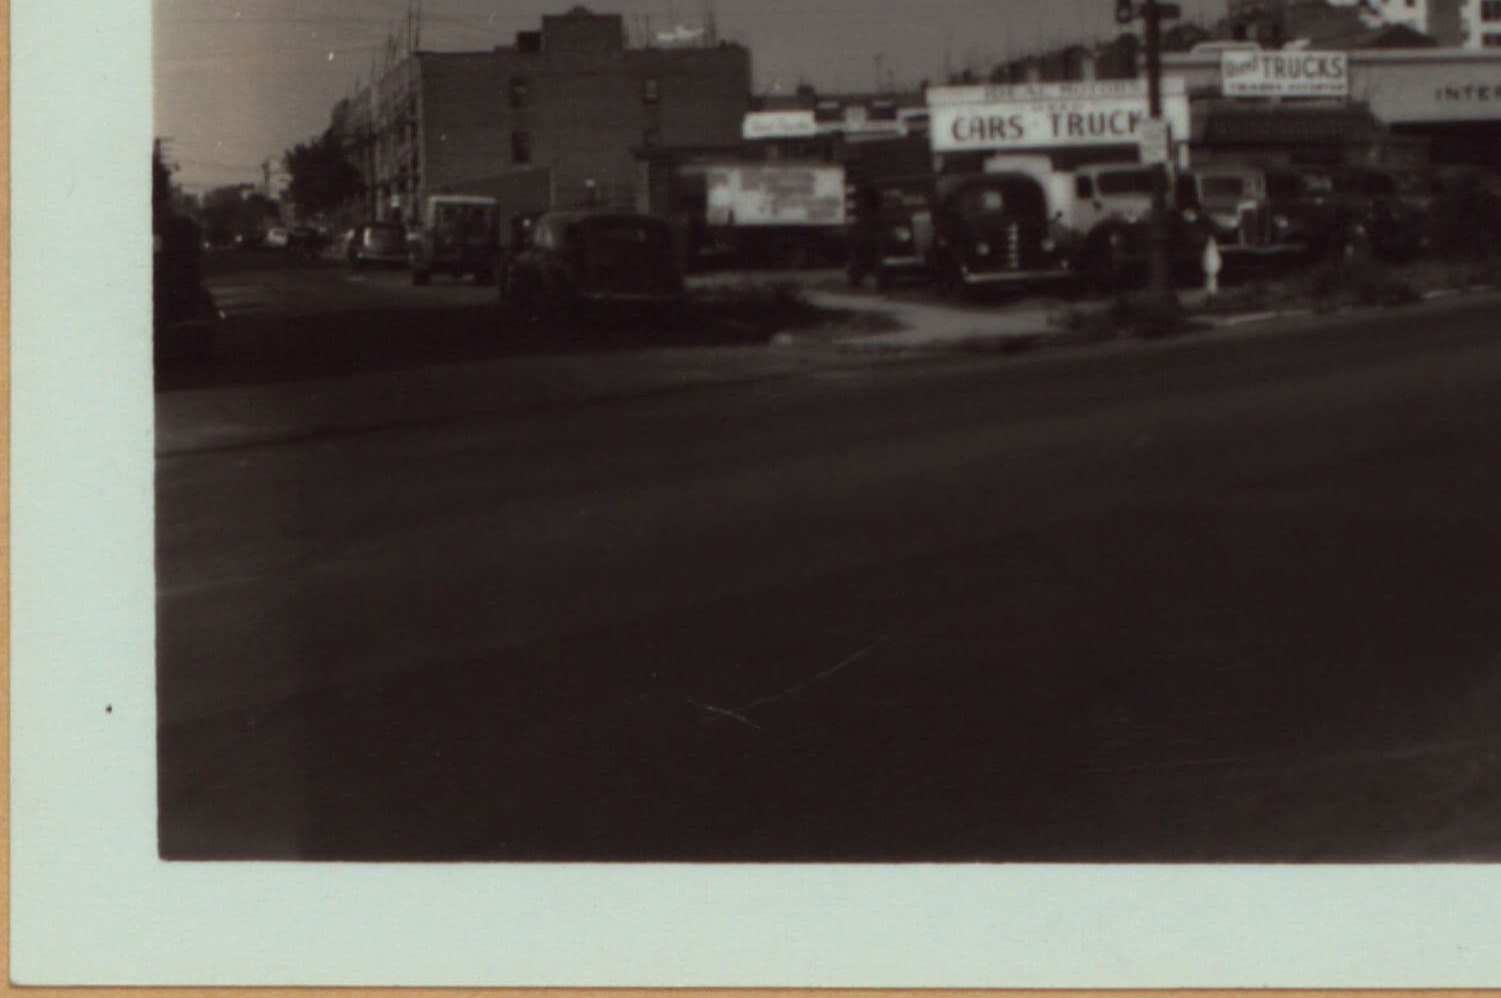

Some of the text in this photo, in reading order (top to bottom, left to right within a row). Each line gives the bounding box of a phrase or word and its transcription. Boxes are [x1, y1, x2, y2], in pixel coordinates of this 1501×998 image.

[1260, 56, 1344, 79] TRUCKS
[951, 109, 1145, 141] CARS TRUCK
